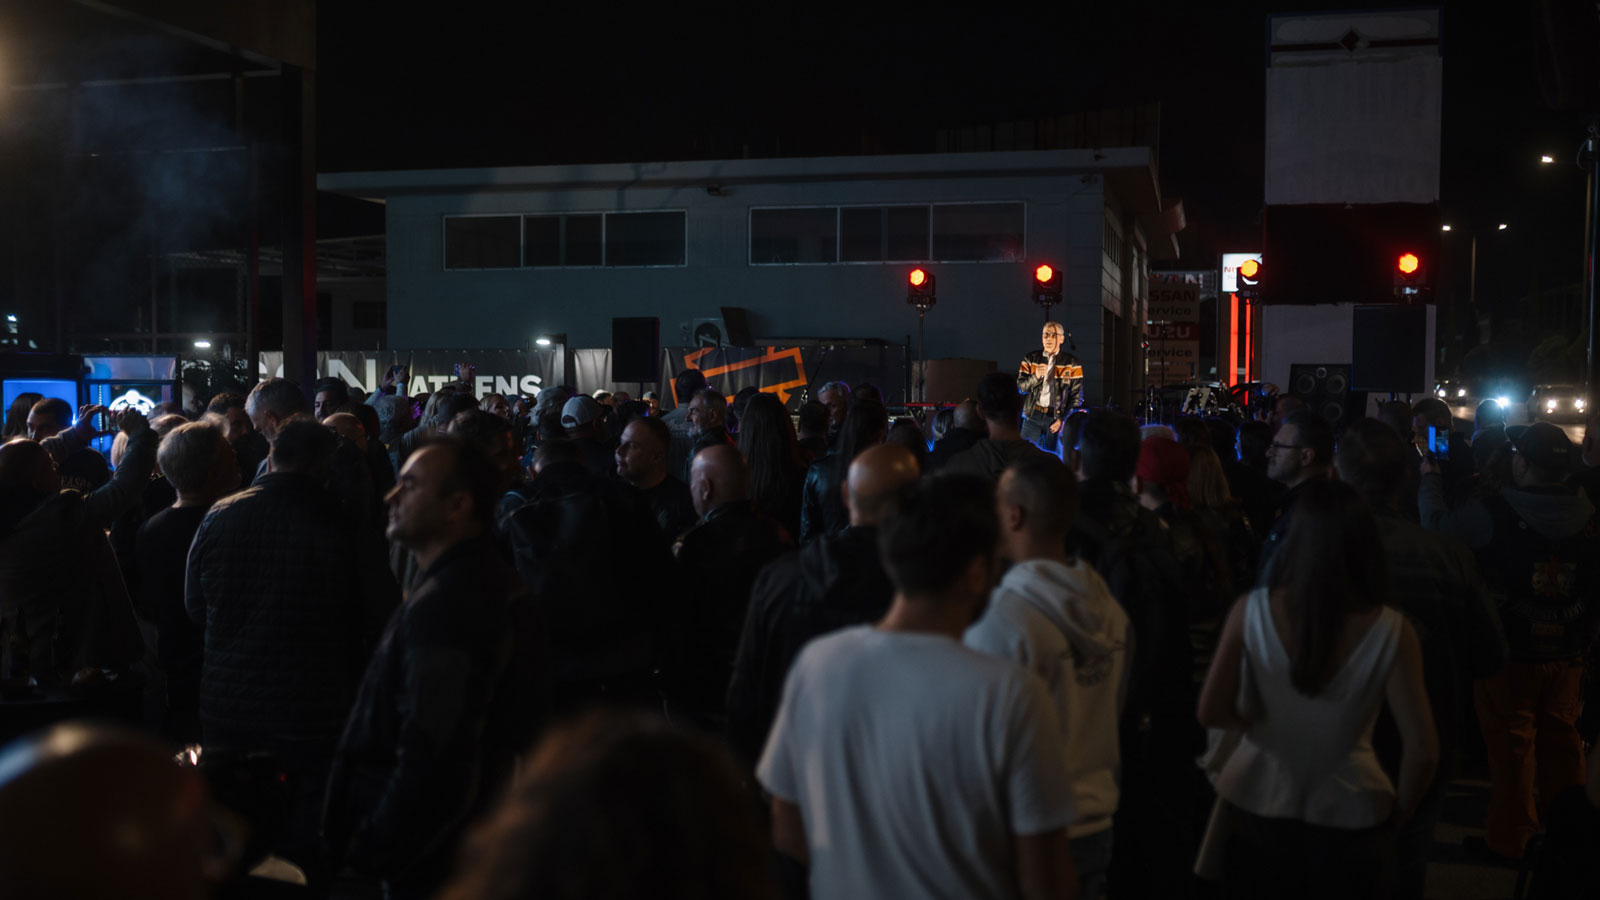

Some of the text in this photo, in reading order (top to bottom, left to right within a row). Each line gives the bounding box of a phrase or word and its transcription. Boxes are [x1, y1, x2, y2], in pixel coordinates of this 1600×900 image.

[1149, 290, 1196, 302] SSAN
[1148, 305, 1192, 315] ervice
[1149, 325, 1191, 339] UZU
[1148, 347, 1193, 358] ervice
[408, 374, 542, 400] ATENS
